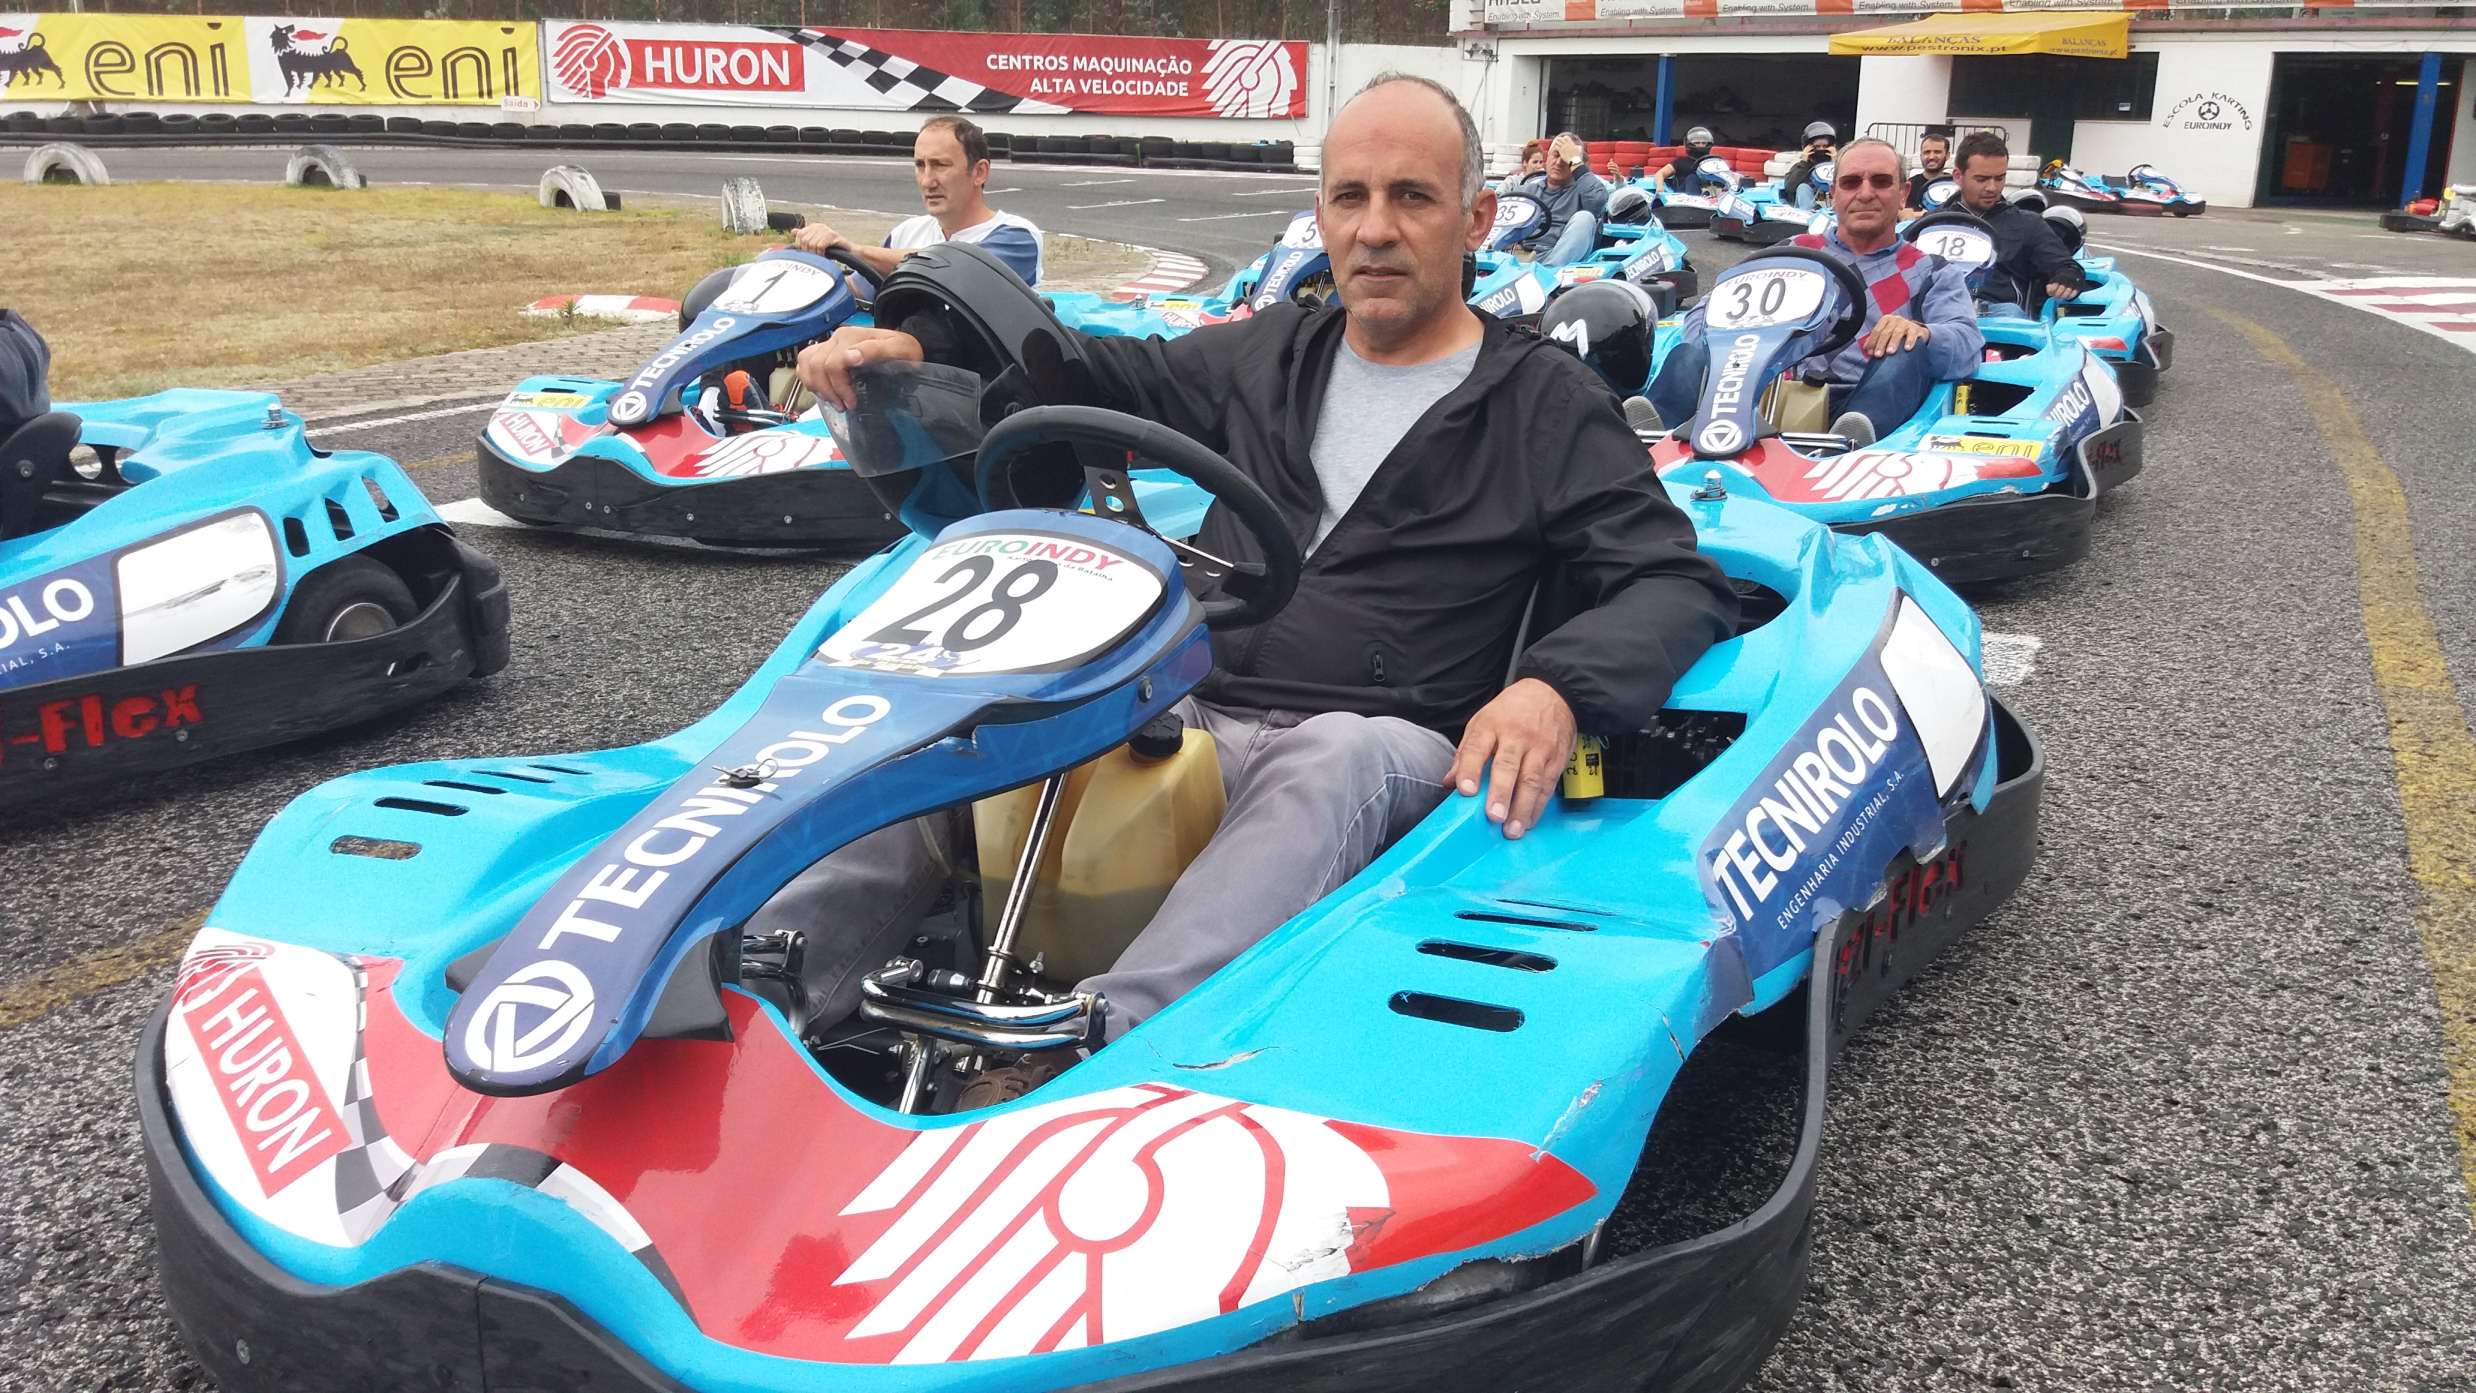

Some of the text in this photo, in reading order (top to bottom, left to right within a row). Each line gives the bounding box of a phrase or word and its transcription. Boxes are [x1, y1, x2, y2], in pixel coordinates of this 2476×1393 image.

[85, 22, 230, 97] eni
[385, 27, 518, 99] eni
[645, 47, 790, 86] HURON
[987, 54, 1192, 78] CENTROS MAQUINAÇÃO
[1030, 78, 1189, 97] ALTA VELOCIDADE
[2163, 92, 2252, 130] ESCOLA KARTING
[2184, 121, 2232, 130] EUROINDY
[1936, 236, 1966, 256] 18
[743, 270, 788, 304] 1
[1726, 278, 1787, 320] 30
[1550, 319, 1588, 361] M
[1971, 441, 2035, 458] eni
[932, 540, 1124, 571] EUROINDY
[862, 554, 1059, 653] 28
[0, 642, 70, 674] IAL, S.A.
[0, 682, 204, 765] -Flex
[1712, 687, 1898, 922] TECNIROLO
[1776, 770, 1905, 931] ENGENHARIA INDUSTRIAL, S.A.
[200, 986, 333, 1175] HURON
